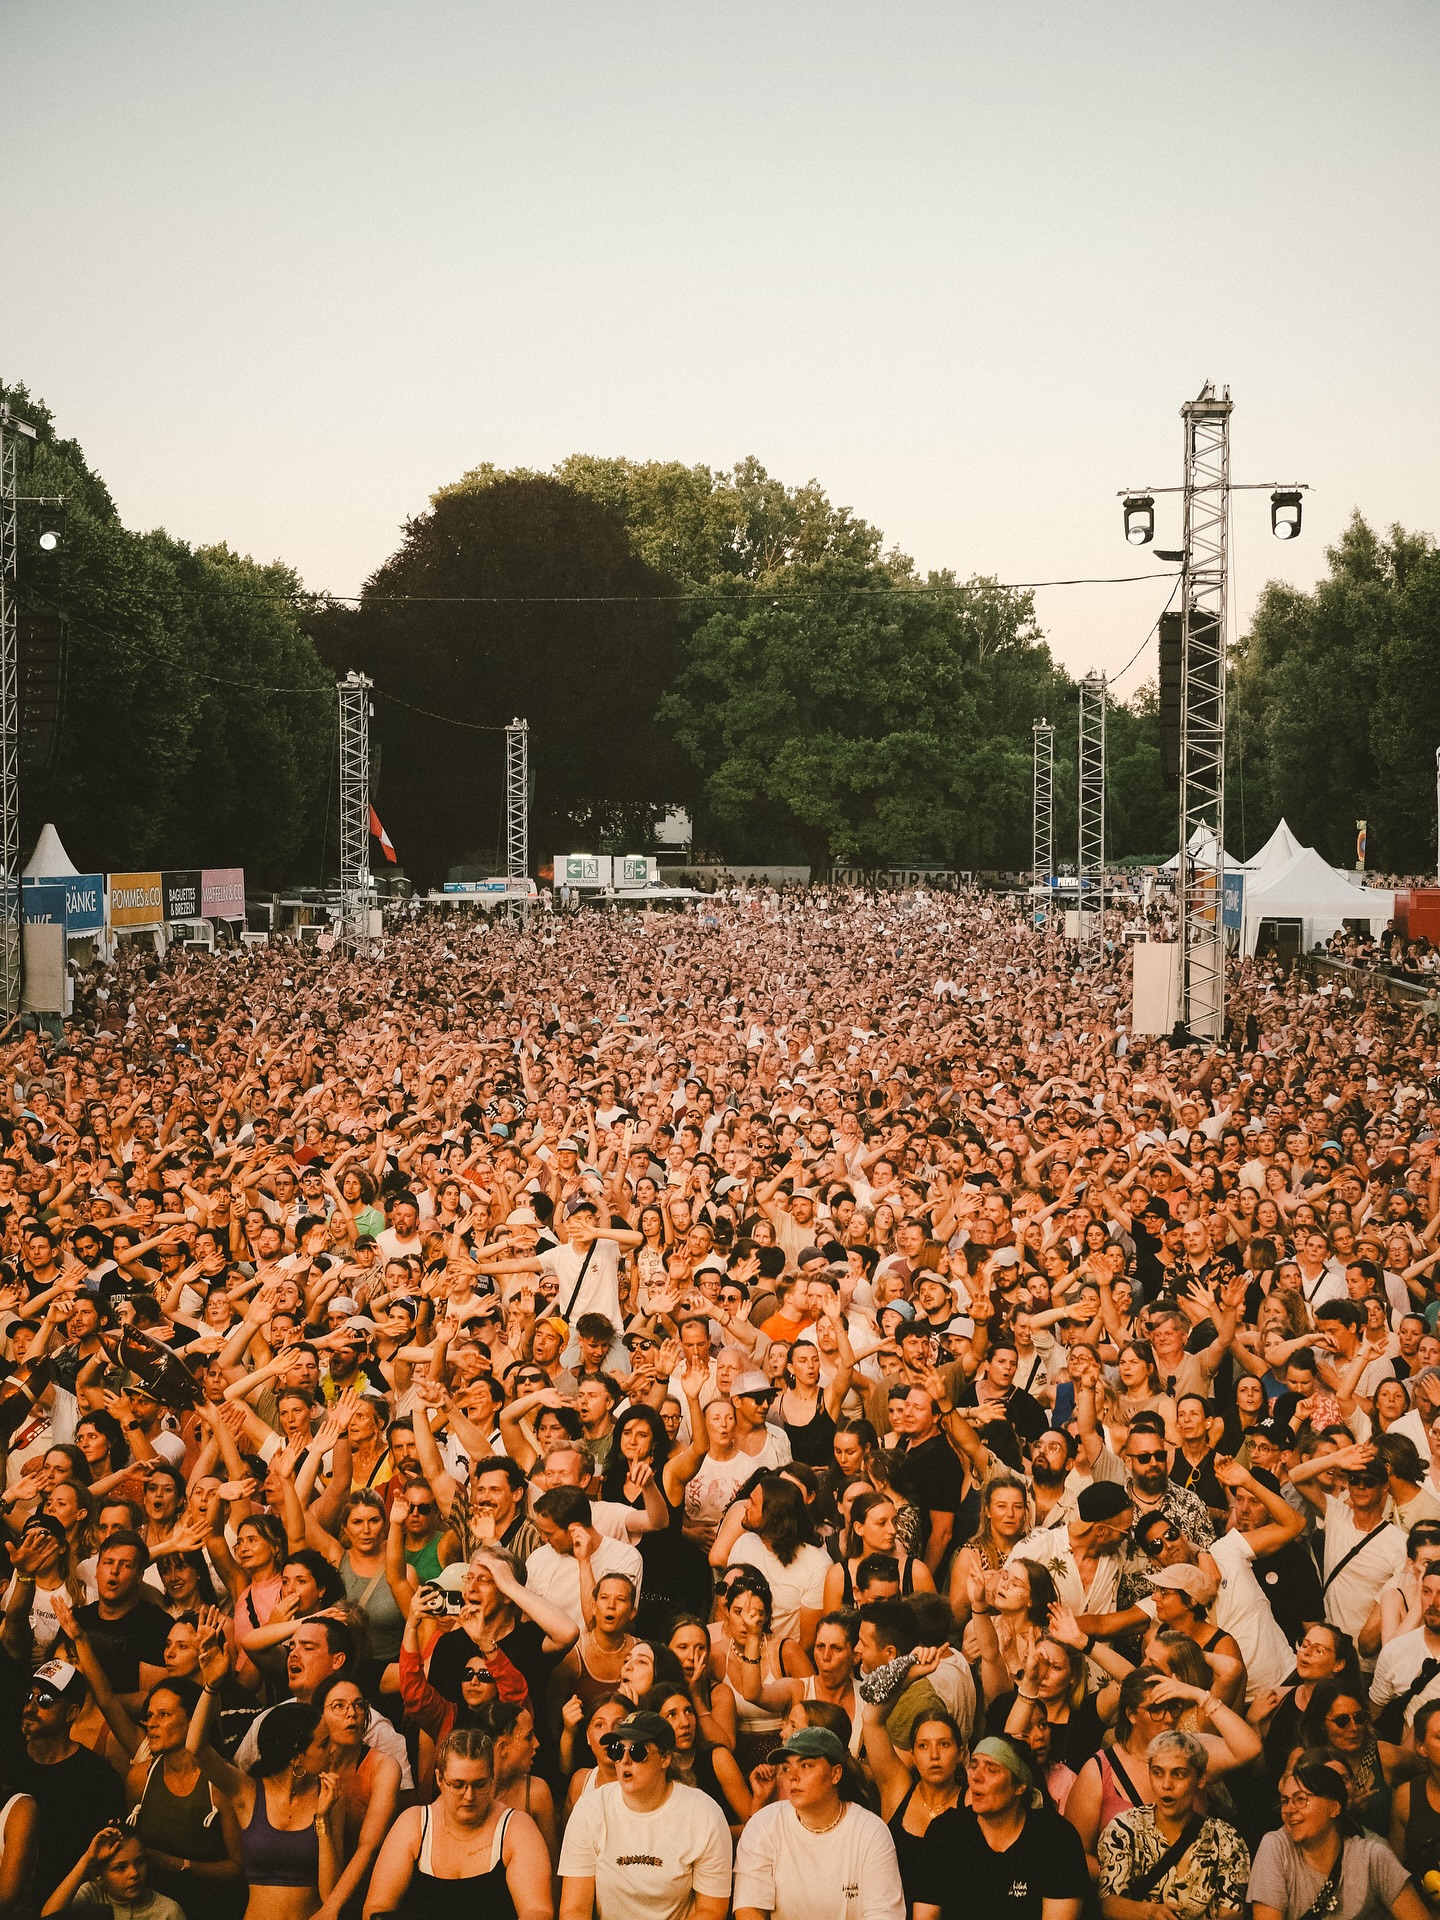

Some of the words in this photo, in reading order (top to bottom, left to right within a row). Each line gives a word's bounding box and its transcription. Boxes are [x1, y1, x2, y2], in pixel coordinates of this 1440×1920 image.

[112, 888, 145, 910] POMMES
[169, 887, 196, 902] BAGUETTES
[203, 886, 229, 903] WAFFELN
[175, 902, 196, 916] BREZELN
